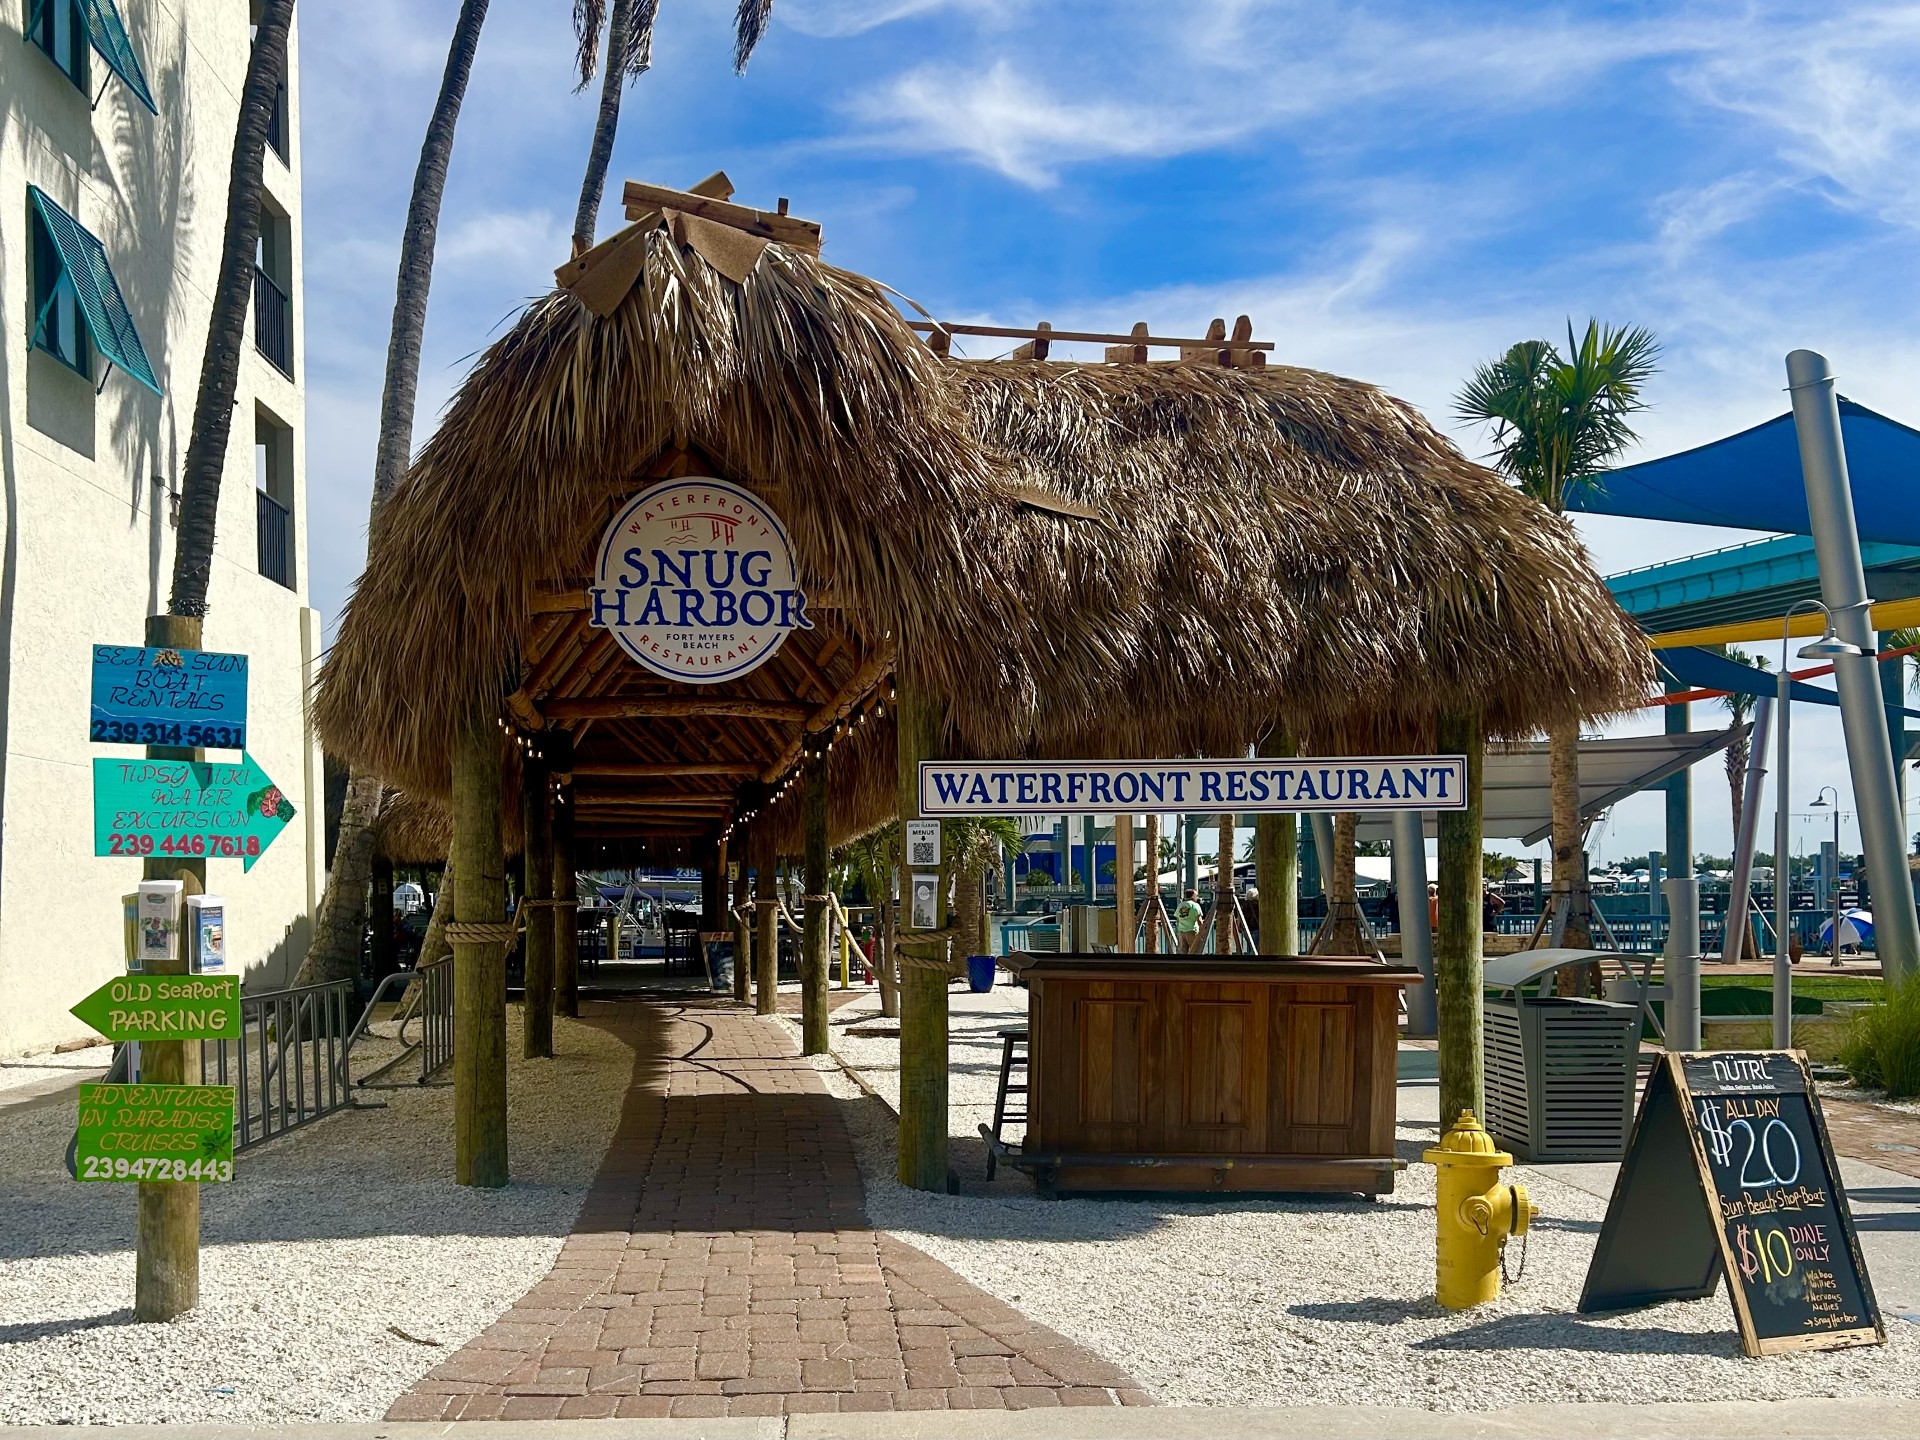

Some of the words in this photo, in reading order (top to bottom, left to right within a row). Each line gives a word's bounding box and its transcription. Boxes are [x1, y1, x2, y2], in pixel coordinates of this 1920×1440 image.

[628, 494, 769, 536] WATERFRONT
[619, 547, 772, 589] SNUG
[591, 588, 812, 628] HARBOR
[666, 633, 694, 641] FORT
[699, 633, 735, 641] MYERS
[682, 641, 719, 650] BEACH
[94, 647, 147, 667] SEA
[191, 653, 247, 673] SUN
[639, 634, 758, 666] RESTAURANT
[135, 669, 208, 691] BOAT
[110, 686, 224, 711] RENTALS
[118, 764, 190, 788] TIPSY
[201, 767, 250, 786] TIKI
[931, 771, 1192, 804] WATERFRONT
[1199, 766, 1455, 801] RESTAURANT
[151, 788, 233, 806] WATER
[112, 811, 251, 830] EXCURSION
[108, 833, 154, 855] 239
[160, 835, 205, 855] 446
[208, 835, 260, 856] 7618
[111, 982, 152, 1002] OLD
[109, 1008, 228, 1032] PARKING
[80, 1086, 235, 1107] ADVENTURES
[1726, 1099, 1755, 1119] ALL
[1755, 1097, 1780, 1118] DAY
[81, 1109, 107, 1128] IN
[113, 1109, 226, 1129] PARADISE
[100, 1132, 198, 1151] CRUISES
[1701, 1099, 1800, 1188] $20
[83, 1156, 232, 1182] 2394728443
[1788, 1223, 1827, 1244] DINE
[1737, 1223, 1794, 1283] $10
[1796, 1244, 1830, 1262] ONLY
